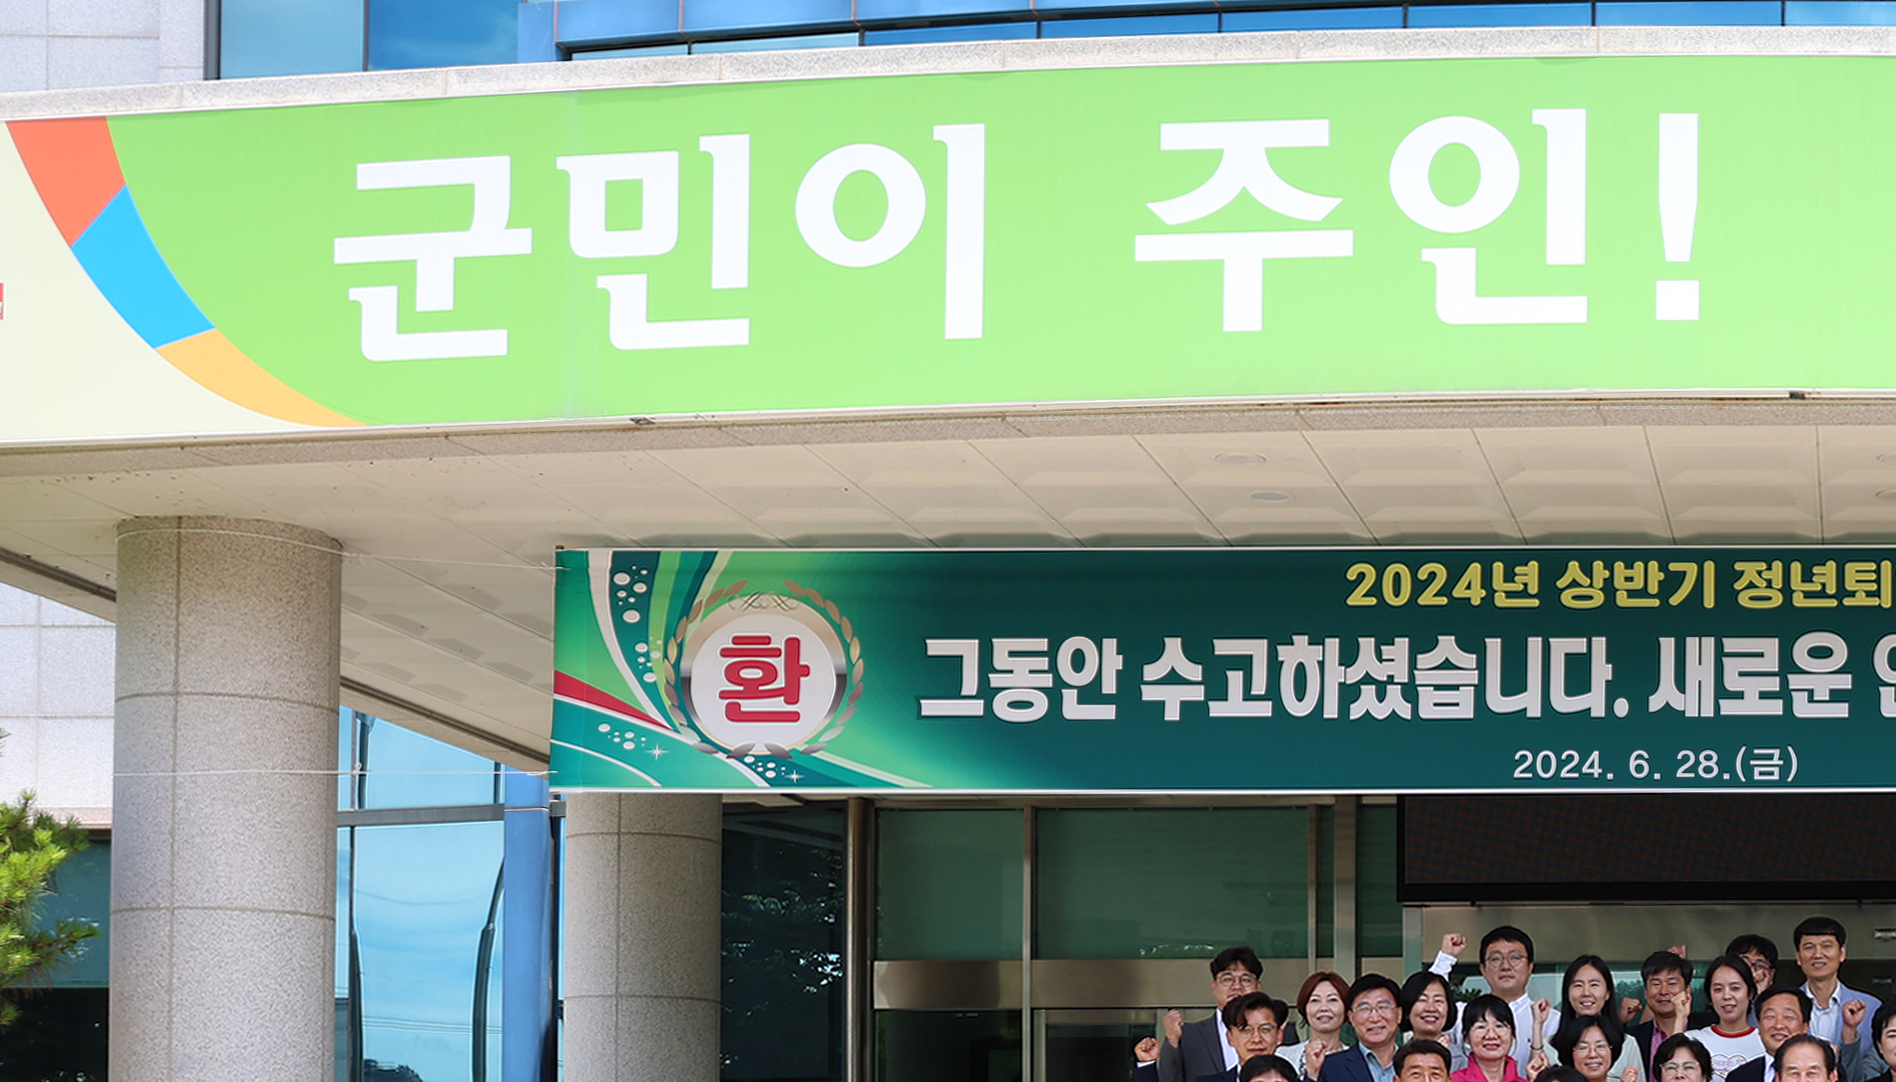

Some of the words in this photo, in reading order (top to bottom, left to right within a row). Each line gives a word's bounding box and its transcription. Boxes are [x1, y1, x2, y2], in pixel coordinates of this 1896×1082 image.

[334, 123, 986, 362] 군민이
[1134, 108, 1700, 332] 주인!
[1348, 561, 1539, 607] 2024년
[1558, 561, 1714, 608] 상반기
[718, 634, 811, 723] 환
[920, 637, 1122, 722] 그동안
[1141, 636, 1628, 720] 수고하셨습니다.
[1649, 633, 1851, 717] 새로운
[1514, 750, 1613, 779] 2024.
[1630, 750, 1660, 779] 6.
[1677, 746, 1797, 781] 28.(금)
